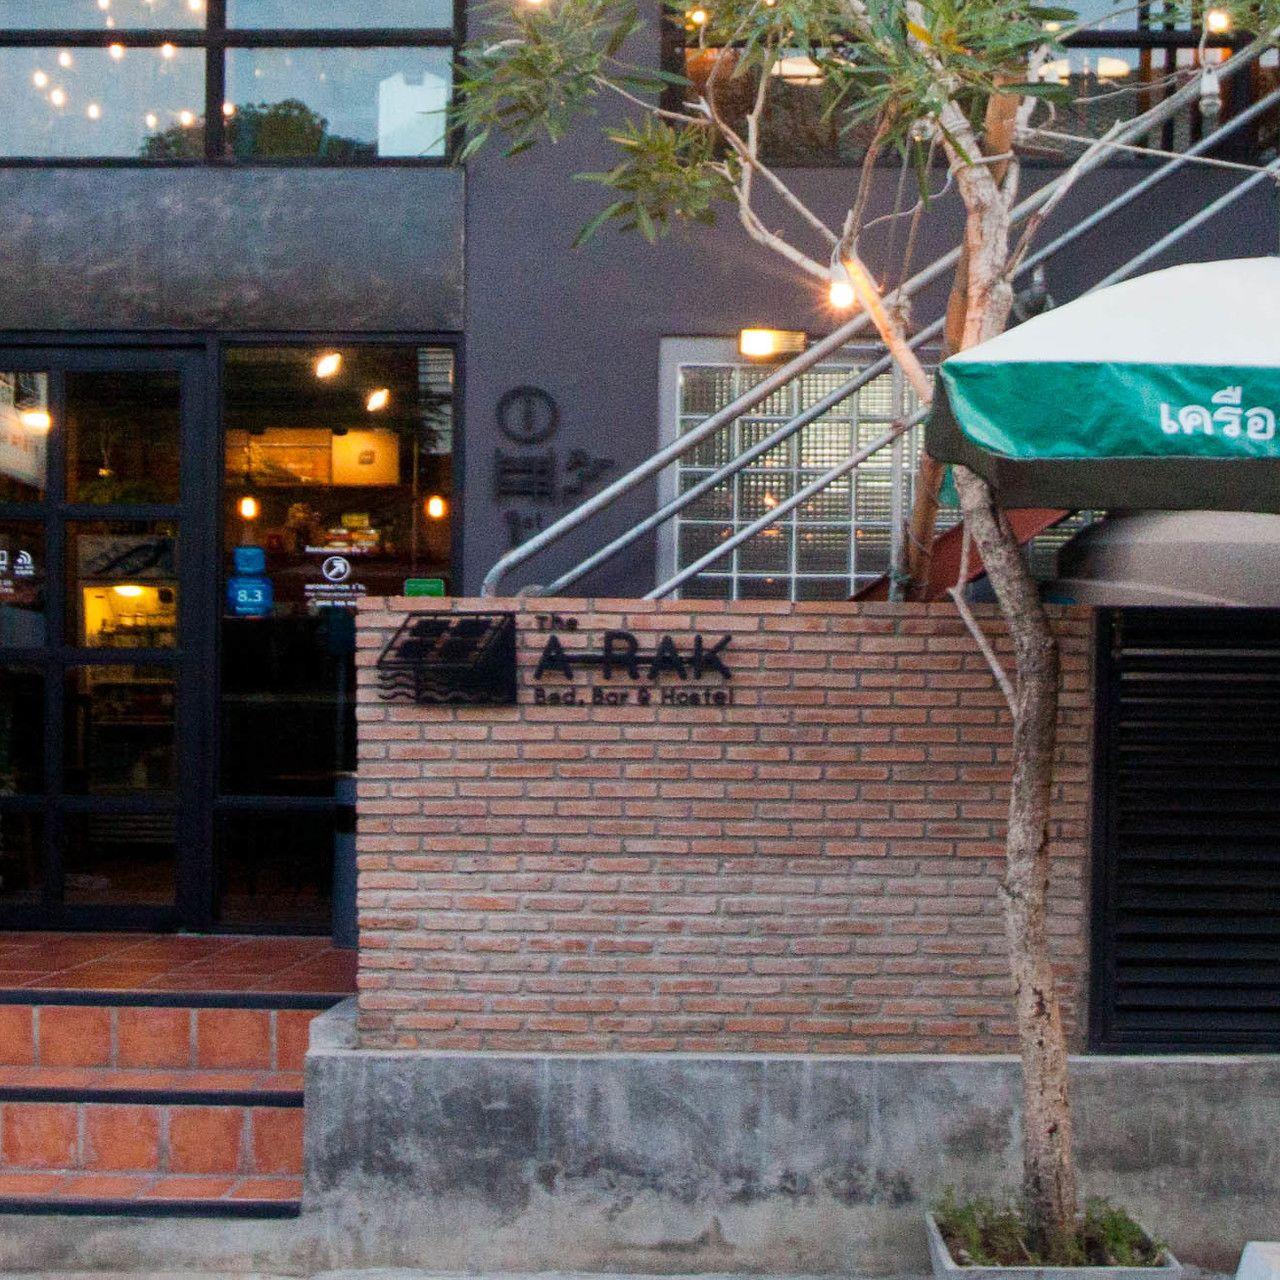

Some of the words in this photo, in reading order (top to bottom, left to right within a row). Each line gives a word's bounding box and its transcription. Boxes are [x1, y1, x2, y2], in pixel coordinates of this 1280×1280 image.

[236, 589, 263, 603] 8.3
[534, 614, 578, 632] The
[533, 631, 733, 680] A-RAK
[593, 687, 629, 706] Bar
[661, 687, 735, 706] Hostel
